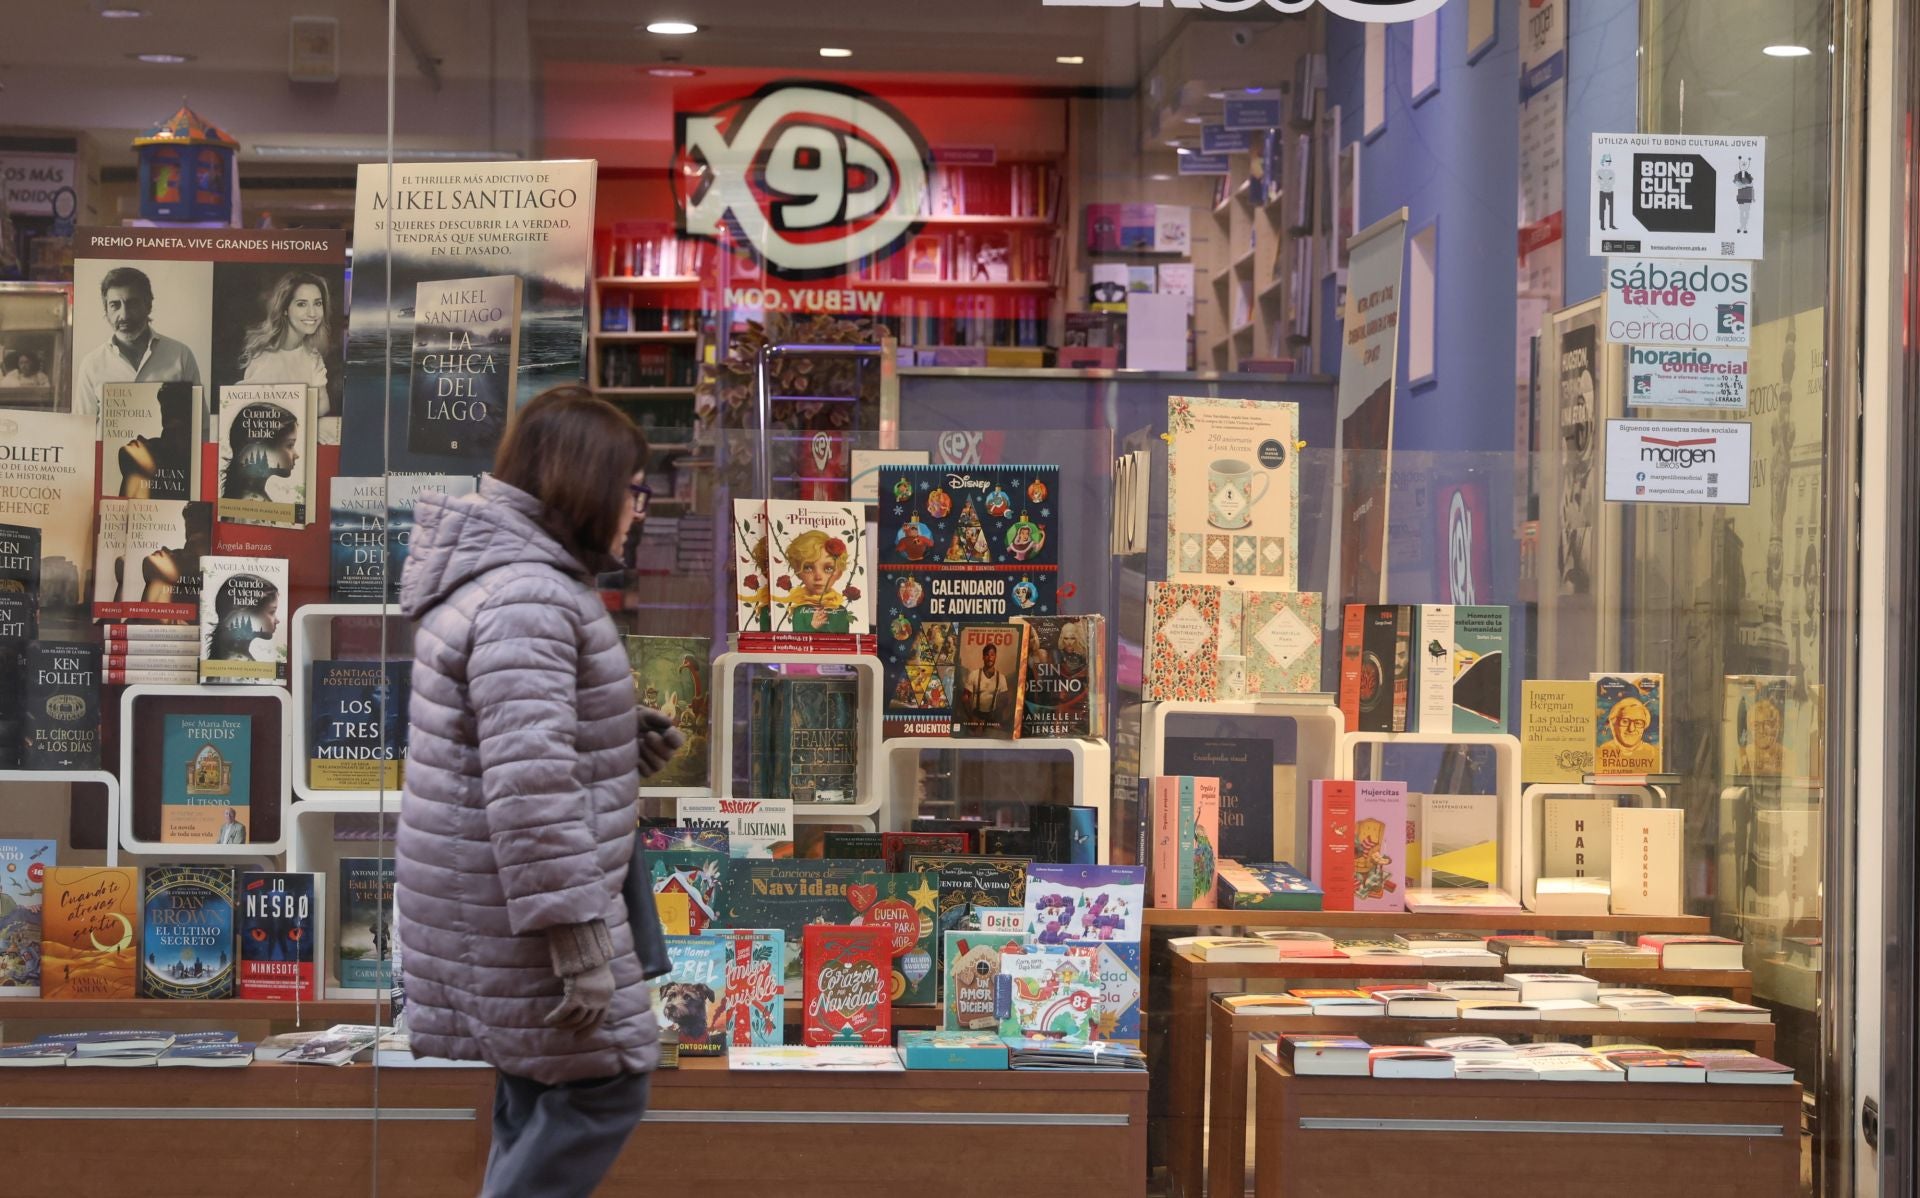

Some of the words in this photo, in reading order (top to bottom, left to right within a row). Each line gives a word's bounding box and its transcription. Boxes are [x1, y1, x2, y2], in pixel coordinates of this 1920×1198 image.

[1598, 137, 1628, 145] UTILIZA
[1631, 137, 1649, 146] AQUÍ
[1664, 138, 1687, 146] BONO
[1689, 139, 1729, 147] CULTURAL
[1640, 161, 1694, 177] BONO
[402, 175, 412, 185] EL
[415, 175, 461, 185] THRILLER
[463, 173, 483, 184] MÁS
[485, 174, 533, 184] ADICTIVO
[536, 174, 550, 183] DE
[1640, 177, 1692, 193] CULT
[372, 190, 447, 211] MIKEL
[452, 188, 577, 211] SANTIAGO
[1640, 193, 1693, 210] URAL
[375, 221, 385, 230] SI
[391, 220, 435, 232] QUIERES
[439, 219, 501, 230] DESCUBRIR
[505, 219, 519, 229] LA
[523, 219, 571, 230] VERDAD,
[91, 236, 133, 248] PREMIO
[136, 236, 186, 248] PLANETA.
[188, 238, 213, 249] VIVE
[215, 239, 268, 250] GRANDES
[271, 239, 328, 251] HISTORIAS
[396, 231, 448, 243] TENDRÁS
[451, 233, 475, 244] QUE
[478, 232, 549, 242] SUMERGIRTE
[431, 246, 447, 256] EN
[450, 246, 463, 256] EL
[465, 245, 512, 256] PASADO.
[1610, 262, 1748, 293] sábados
[441, 290, 487, 305] MIKEL
[1622, 284, 1696, 307] tarde
[424, 308, 502, 325] SANTIAGO
[1609, 317, 1708, 342] cerrado
[449, 332, 472, 350] LA
[1630, 347, 1712, 365] horario
[422, 353, 497, 375] CHICA
[1662, 361, 1748, 375] comercial
[106, 388, 132, 398] VERA
[437, 377, 477, 398] DEL
[263, 391, 300, 400] BANZAS
[105, 398, 127, 408] UNA
[105, 409, 152, 418] HISTORIA
[242, 408, 281, 420] Cuando
[427, 401, 488, 422] LAGO
[105, 419, 118, 428] DE
[242, 419, 251, 429] el
[252, 420, 281, 430] viento
[105, 430, 134, 438] AMOR
[247, 428, 275, 439] hable
[0, 446, 64, 464] OLLETT
[1640, 447, 1716, 468] margen
[10, 464, 21, 472] DE
[24, 465, 38, 473] LOS
[41, 466, 77, 474] MAYORES
[155, 468, 185, 480] JUAN
[5, 472, 15, 480] LA
[17, 473, 55, 482] HISTORIA
[140, 479, 163, 490] DEL
[164, 481, 185, 491] VAL
[0, 502, 50, 515] EHENGE
[798, 508, 807, 517] El
[361, 516, 384, 531] LA
[786, 513, 846, 528] Principito
[217, 542, 243, 552] Ángela
[245, 543, 272, 551] Banzas
[932, 579, 1005, 596] CALENDARIO
[930, 598, 945, 614] DE
[948, 598, 1006, 615] ADVIENTO
[967, 632, 1014, 646] FUEGO
[54, 658, 79, 670] KEN
[1038, 663, 1061, 676] SIN
[38, 670, 94, 686] FOLLETT
[1530, 690, 1565, 701] Ingmar
[340, 700, 372, 714] LOS
[1530, 701, 1574, 712] Bergman
[1529, 714, 1547, 724] Las
[1549, 714, 1590, 725] palabras
[36, 729, 48, 741] EL
[50, 727, 94, 741] CÍRCULO
[332, 722, 379, 738] TRES
[904, 723, 914, 733] 24
[915, 723, 951, 734] CUENTOS
[1031, 725, 1069, 734] JENSEN
[38, 742, 45, 750] de
[47, 741, 68, 752] LOS
[70, 739, 92, 752] DÍAS
[318, 745, 394, 760] MUNDOS
[1602, 749, 1621, 758] RAY
[1602, 759, 1654, 768] BRADBURY
[1361, 788, 1400, 797] Mujercitas
[719, 800, 760, 814] Astérix
[738, 817, 786, 836] LUSITANIA
[771, 868, 821, 879] Canciones
[822, 868, 833, 878] de
[271, 878, 285, 893] JO
[971, 876, 1010, 890] NAVIDAD
[61, 880, 105, 908] Cuando
[67, 897, 114, 921] atrevas
[171, 896, 205, 909] DAN
[246, 894, 309, 918] NESBØ
[153, 909, 225, 925] BROWN
[874, 908, 909, 920] CUENTA
[894, 922, 916, 933] PARA
[987, 915, 1020, 928] Osito
[156, 926, 170, 936] EL
[173, 924, 221, 936] ÚLTIMO
[160, 936, 215, 946] SECRETO
[668, 947, 682, 957] Me
[684, 946, 710, 957] llamo
[251, 962, 298, 974] MINNESOTA
[72, 976, 109, 985] TAMARA
[818, 964, 879, 994] Corazón
[976, 979, 989, 988] UN
[71, 985, 109, 994] MOLINA
[960, 988, 993, 1000] AMOR
[809, 980, 886, 1017] Navidad
[680, 1043, 722, 1051] ONTGOMERY
